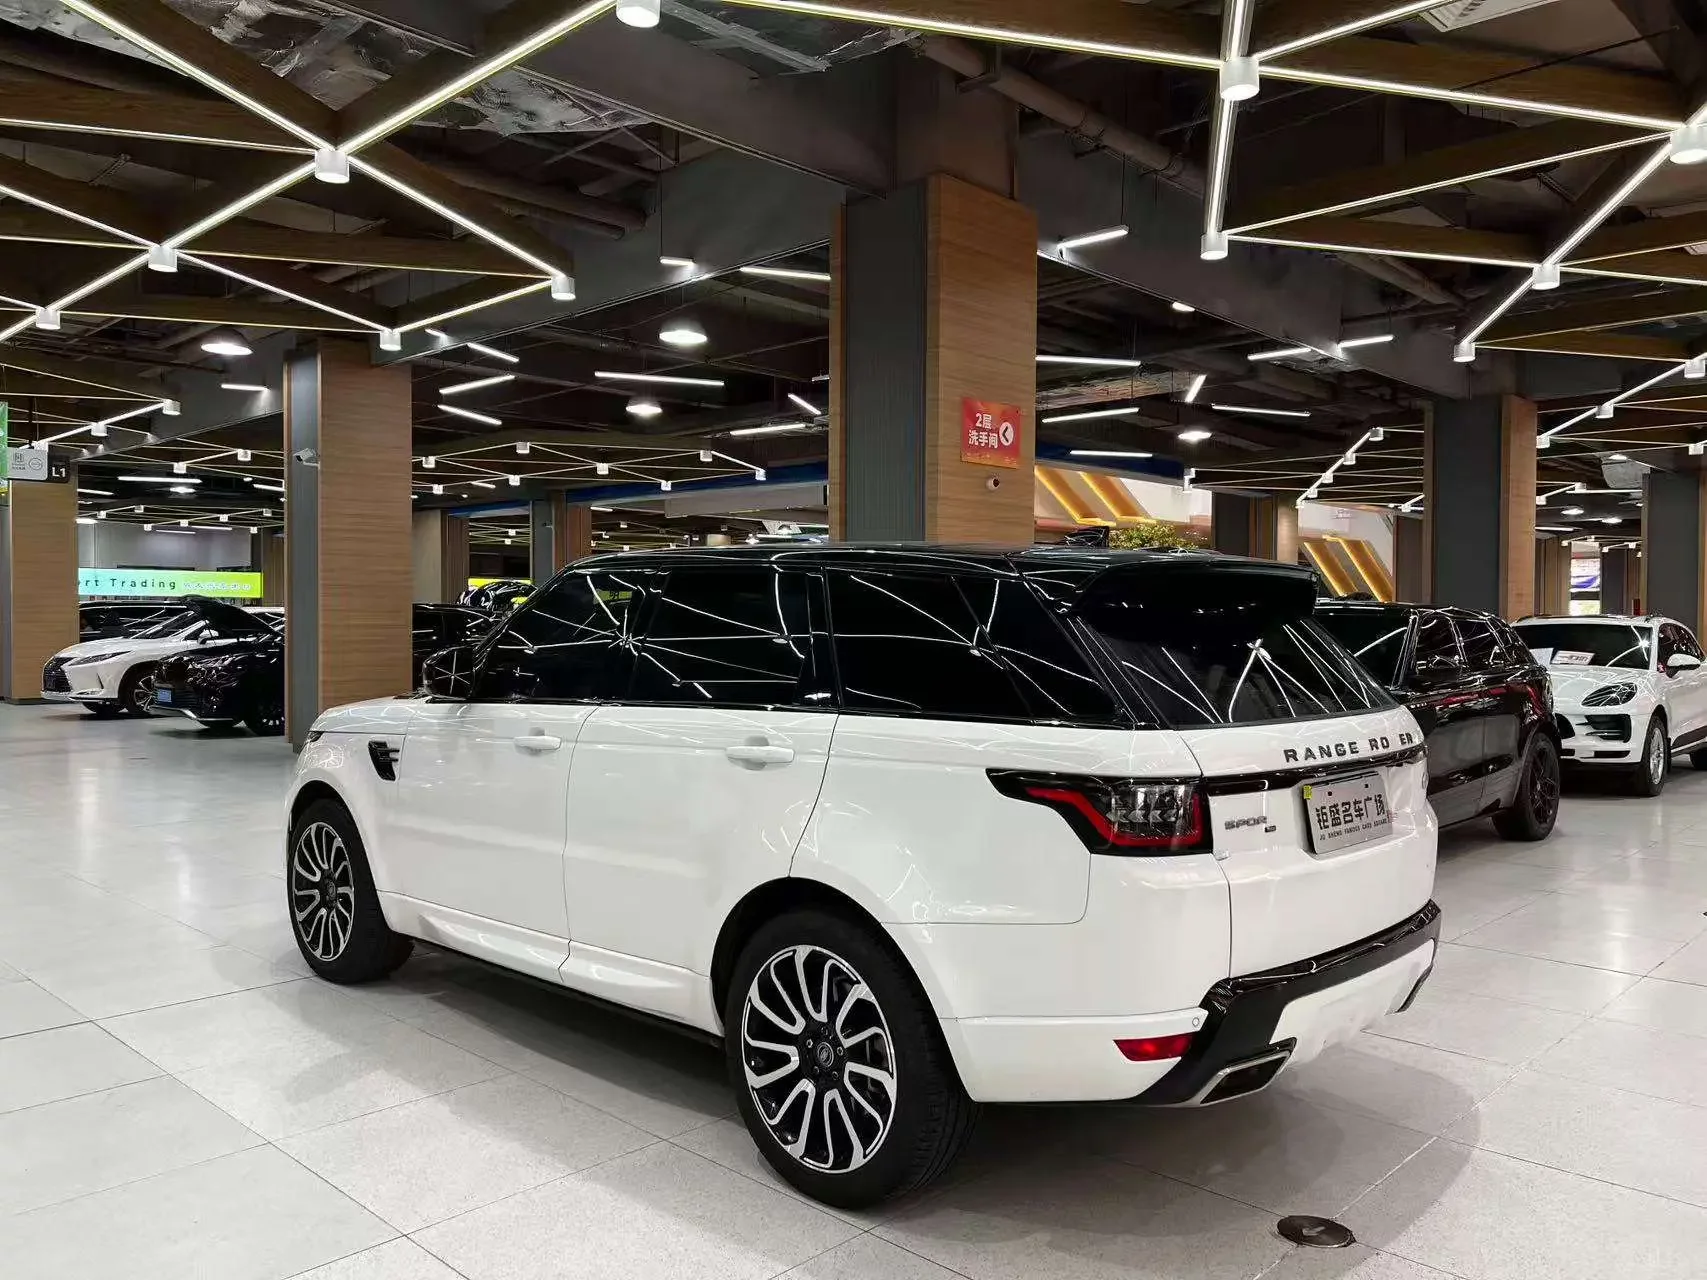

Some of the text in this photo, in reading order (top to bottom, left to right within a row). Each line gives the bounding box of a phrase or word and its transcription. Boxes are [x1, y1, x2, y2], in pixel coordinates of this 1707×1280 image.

[975, 412, 992, 429] 2层
[968, 429, 998, 449] 洗手间
[51, 466, 66, 478] L1
[110, 578, 176, 590] Trading
[1283, 741, 1360, 763] RANGE
